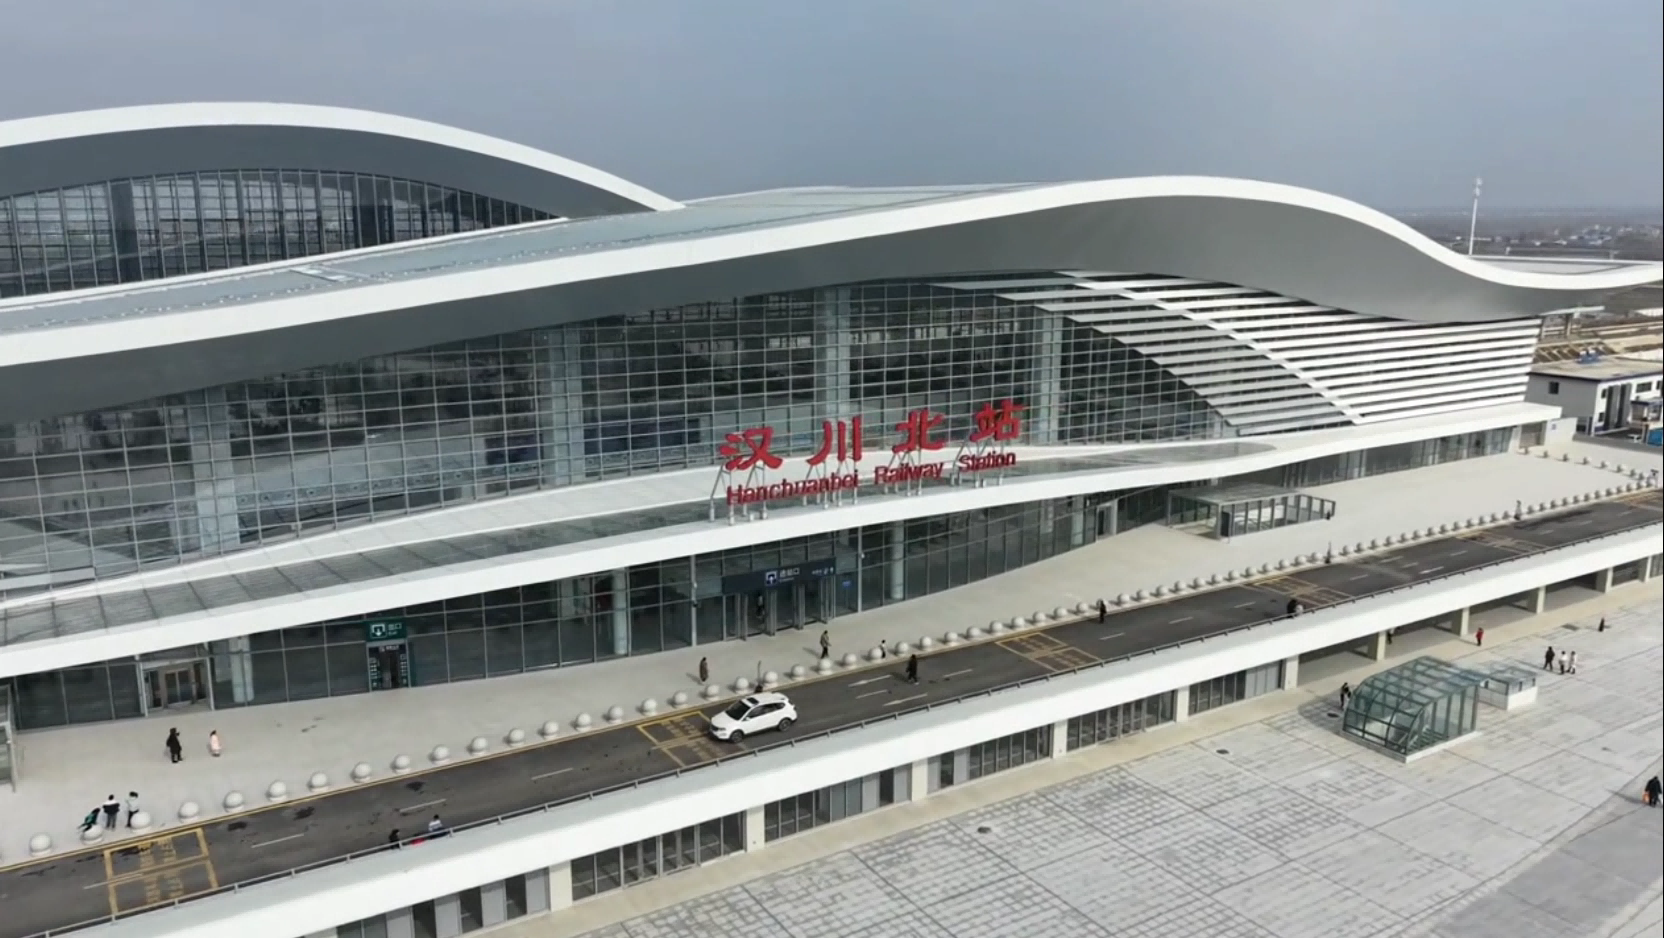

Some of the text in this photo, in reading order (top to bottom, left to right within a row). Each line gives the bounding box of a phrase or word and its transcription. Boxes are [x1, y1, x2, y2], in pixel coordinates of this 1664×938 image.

[719, 398, 1024, 470] 汉川北站
[726, 450, 1017, 505] Hanchuanbei Railway Station
